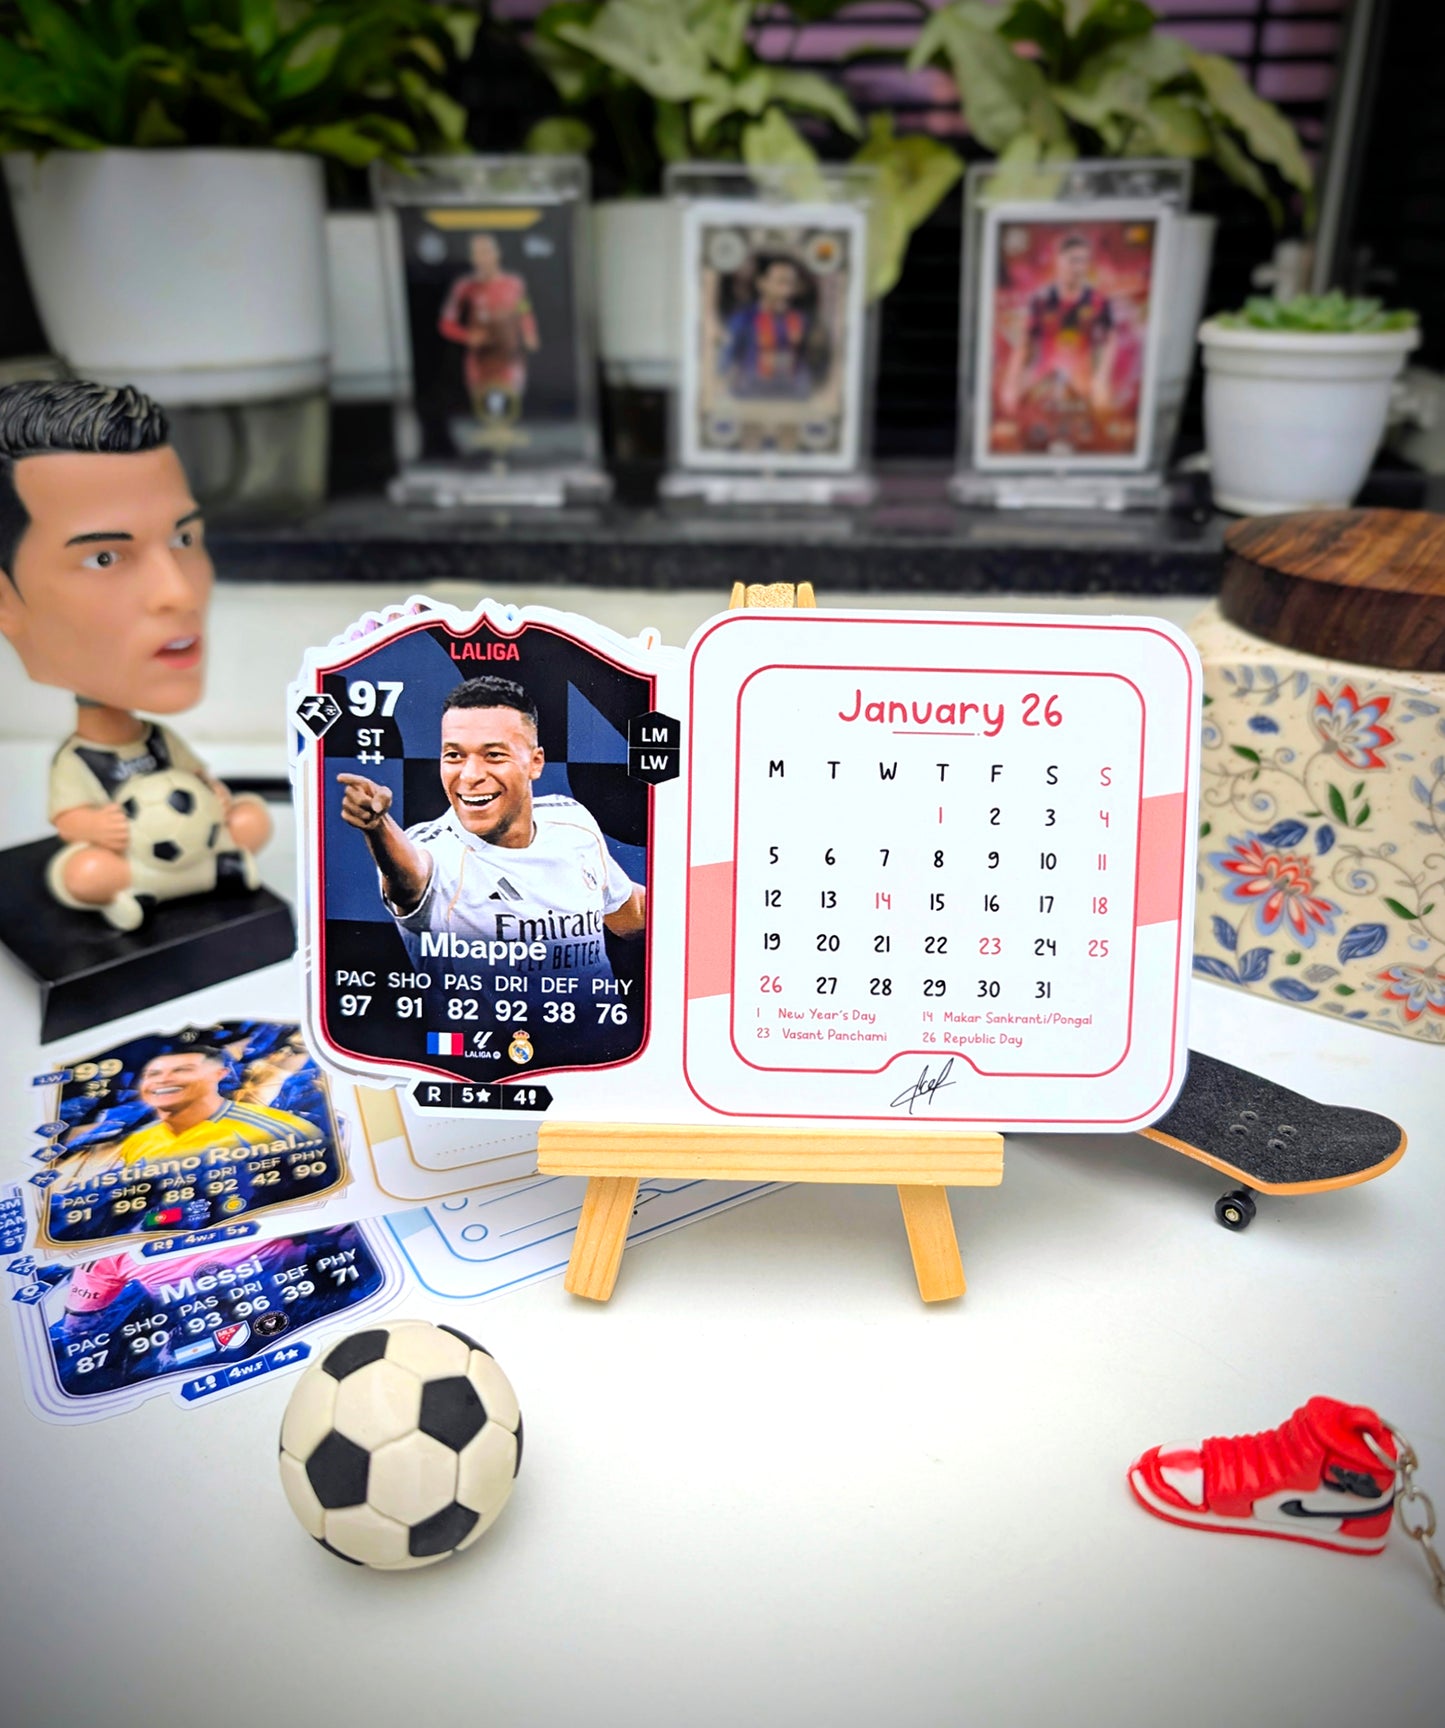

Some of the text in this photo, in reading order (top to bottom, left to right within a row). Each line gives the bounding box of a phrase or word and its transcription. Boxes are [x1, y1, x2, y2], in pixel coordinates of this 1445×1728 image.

[451, 643, 519, 660] LALIGA
[349, 681, 403, 716] 97
[839, 689, 1062, 737] January 26
[358, 729, 384, 746] ST
[642, 728, 667, 742] LM
[641, 756, 668, 769] LW
[769, 760, 1111, 786] M T W T F S S
[939, 807, 1109, 827] 1 2 3 4
[770, 846, 1106, 870] 5 6 7 8 9 10 11
[765, 890, 1107, 914] 12 13 14 15 16 17 18
[421, 932, 548, 966] Mbappé
[764, 933, 1108, 957] 19 20 21 22 23 24 25
[336, 970, 633, 995] PAC SHO PAS DRI DEF PHY
[760, 976, 1050, 998] 26 27 28 29 30 31
[340, 995, 628, 1024] 97 91 82 92 38 76
[778, 1007, 805, 1019] New
[809, 1008, 849, 1020] Year's
[852, 1010, 876, 1024] Day
[922, 1011, 1092, 1028] 14 Makar Sankranti/Pongal
[757, 1028, 887, 1041] 23 Vasant Panchami
[922, 1032, 1023, 1048] 26 Republic Day
[73, 1058, 123, 1082] 99
[428, 1087, 526, 1104] R 5 4
[62, 1148, 326, 1208] PAC SHO PAS DRI DEF PHY
[66, 1162, 326, 1223] 91 96 88 92 42 90
[5, 1234, 24, 1247] ST
[152, 1242, 164, 1250] R
[160, 1254, 263, 1304] Messi
[67, 1248, 356, 1356] PAC SHO PAS DRI DEF PHY
[77, 1265, 359, 1374] 87 90 93 96 39 71
[218, 1328, 236, 1336] MLS
[193, 1381, 206, 1392] L
